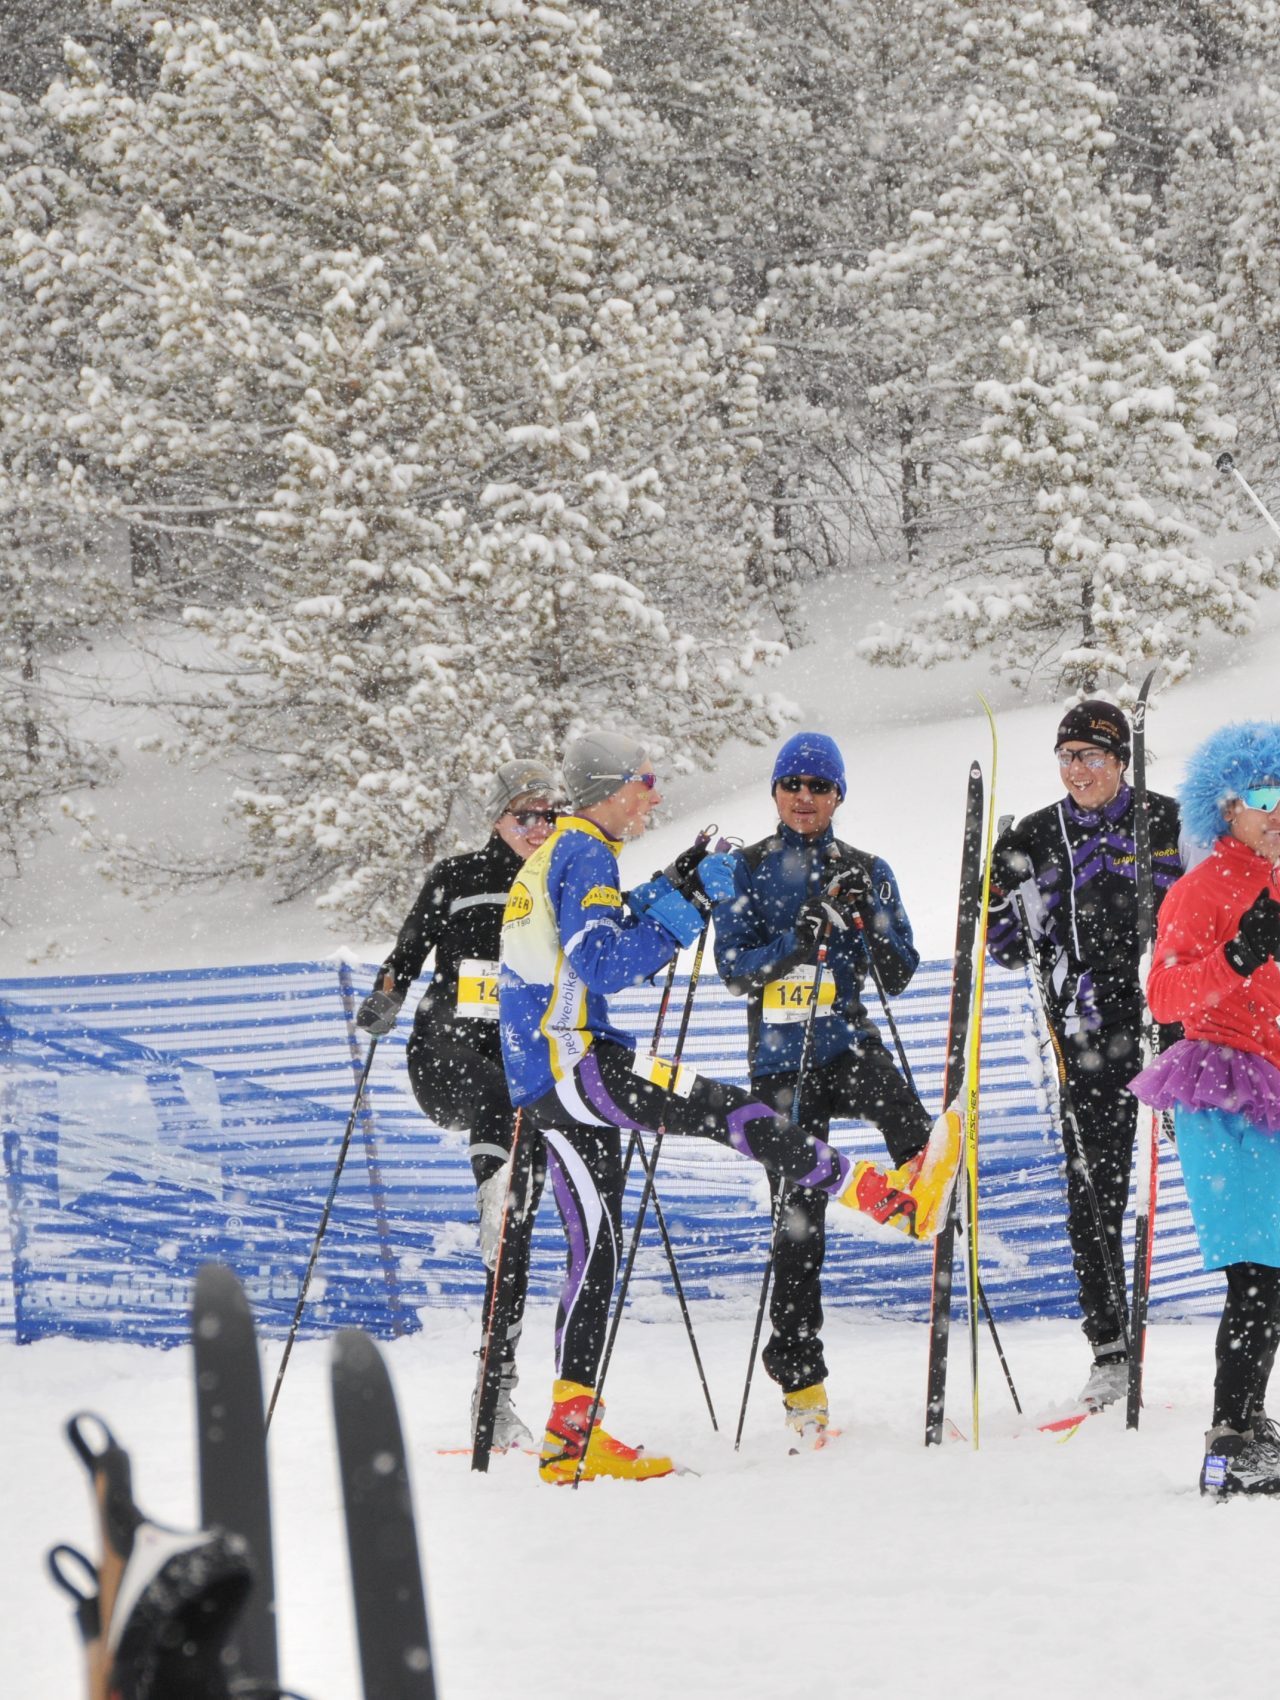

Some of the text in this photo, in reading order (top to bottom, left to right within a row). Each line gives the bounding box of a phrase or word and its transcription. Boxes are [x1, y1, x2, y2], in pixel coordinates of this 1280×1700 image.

[1153, 848, 1179, 857] NORDI
[476, 980, 500, 1002] 14
[777, 985, 816, 1006] 147
